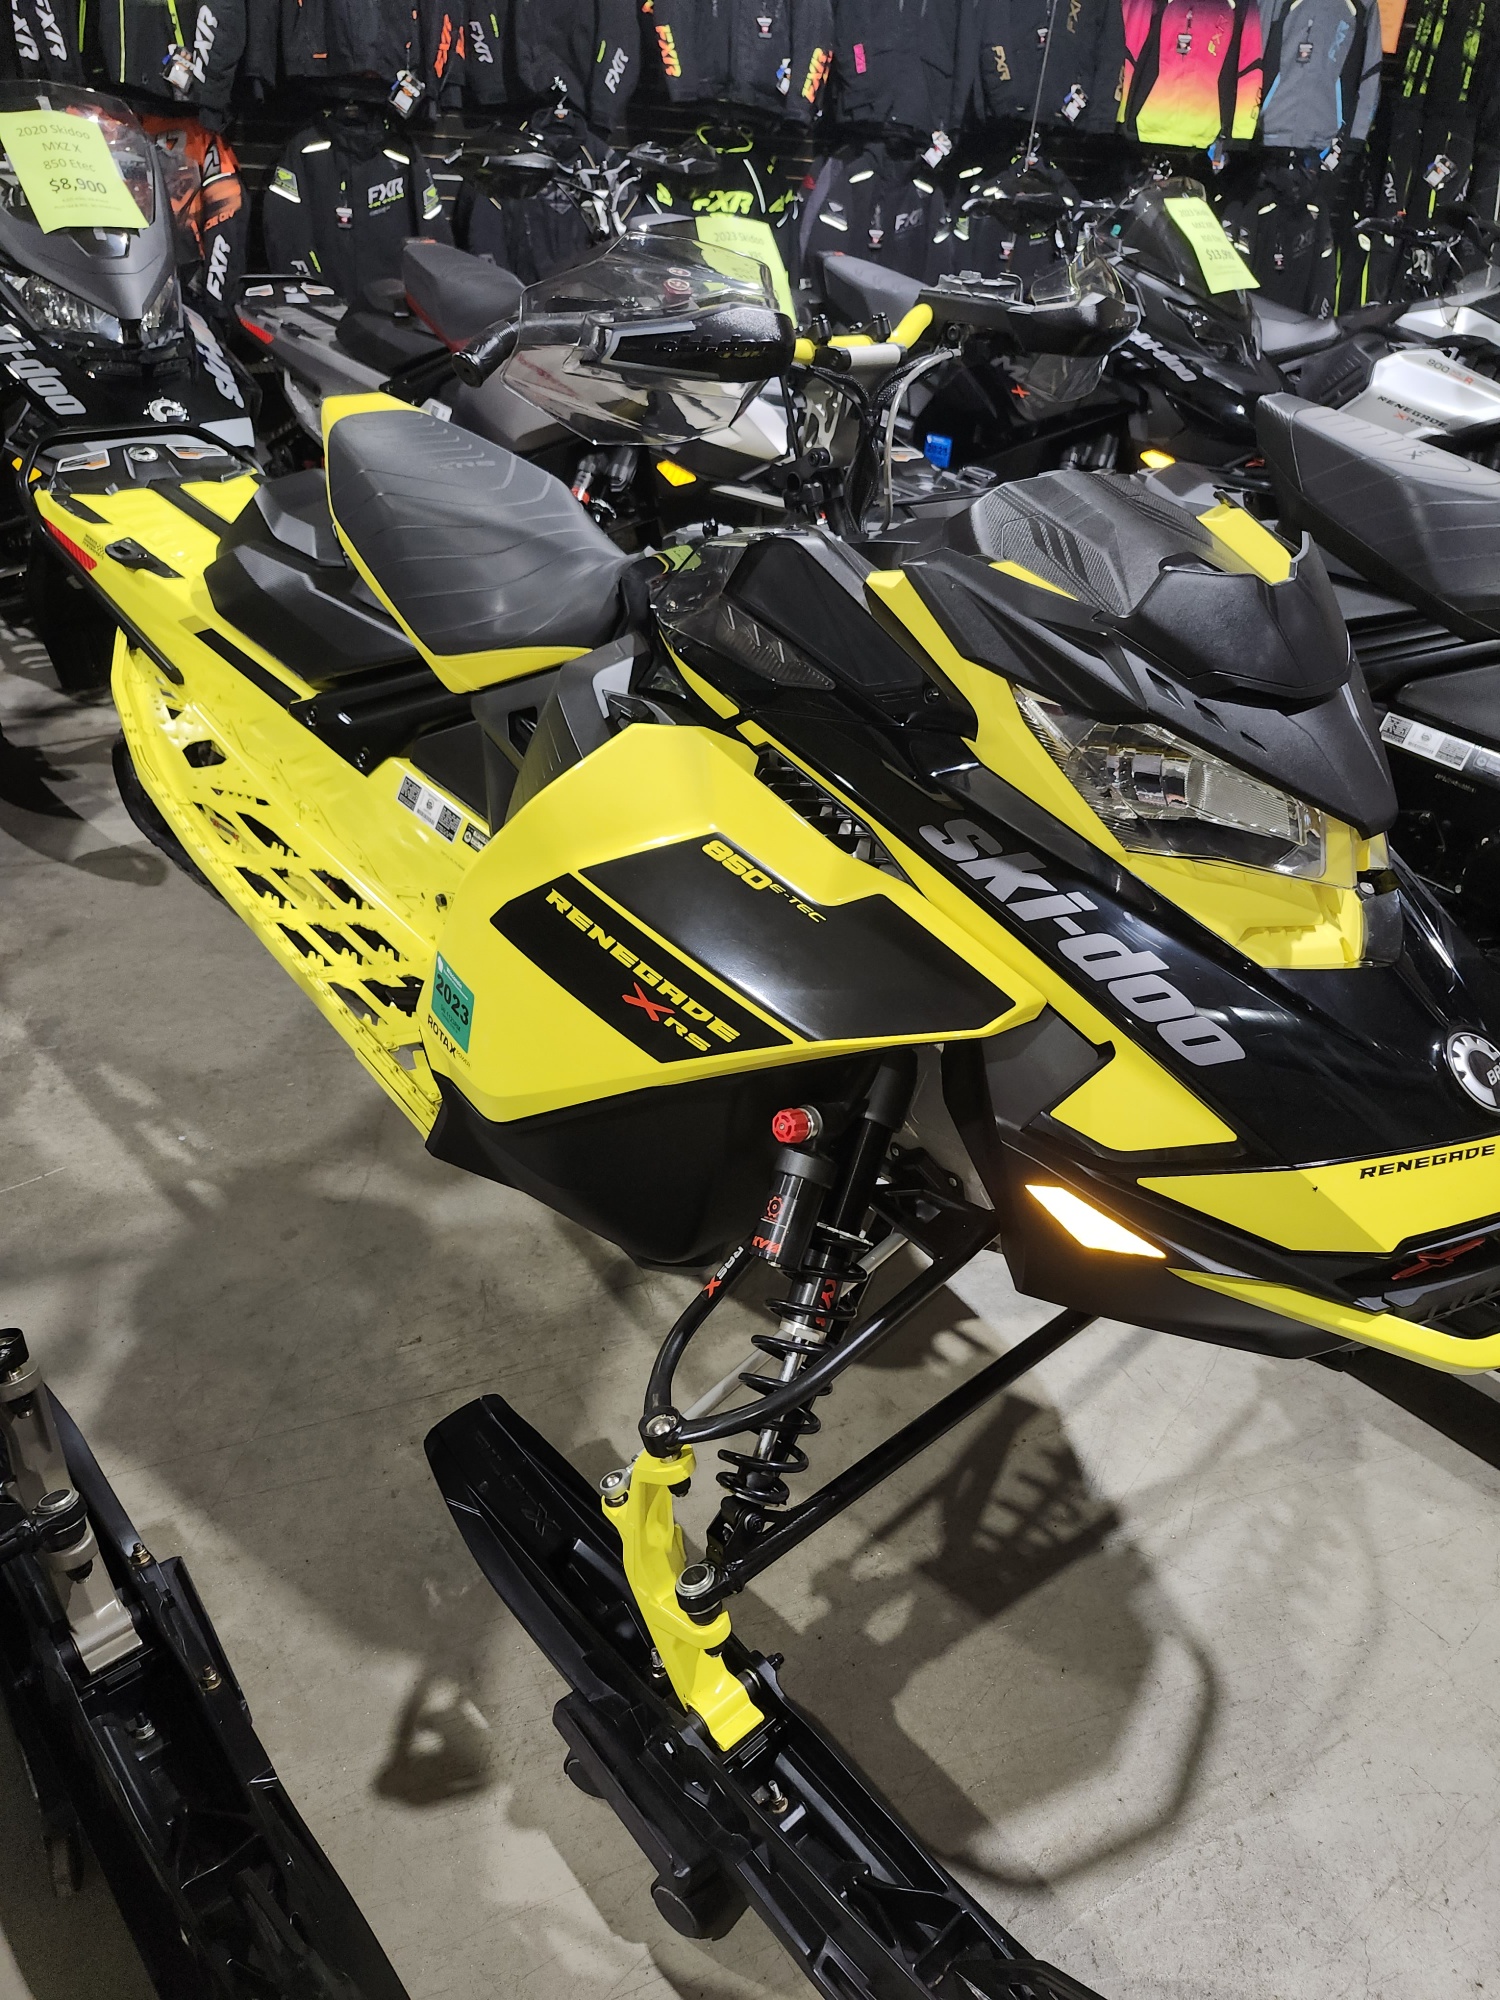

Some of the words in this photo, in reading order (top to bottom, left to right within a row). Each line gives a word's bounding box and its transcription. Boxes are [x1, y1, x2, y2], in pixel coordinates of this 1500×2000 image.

[193, 4, 218, 84] FXR
[469, 21, 493, 64] FXR
[655, 24, 682, 78] FXR
[991, 45, 1011, 81] FXR
[605, 47, 629, 94] FXR
[802, 47, 827, 103] FXR
[16, 124, 48, 137] 2020
[50, 124, 91, 140] Skidoo
[43, 158, 67, 170] 850
[69, 159, 97, 173] Etec
[49, 177, 108, 195] $8,900
[368, 177, 405, 205] FXR
[206, 233, 231, 301] FXR
[1378, 394, 1450, 429] RENEGADE
[701, 839, 773, 891] 850
[769, 883, 827, 923] E-TEC
[545, 887, 741, 1044] RENEGADE
[918, 818, 1246, 1067] ski-doo
[435, 973, 470, 1026] 2023
[427, 1013, 457, 1060] ROTAX
[1486, 1062, 1500, 1087] BR
[1360, 1144, 1496, 1180] RENEGADE
